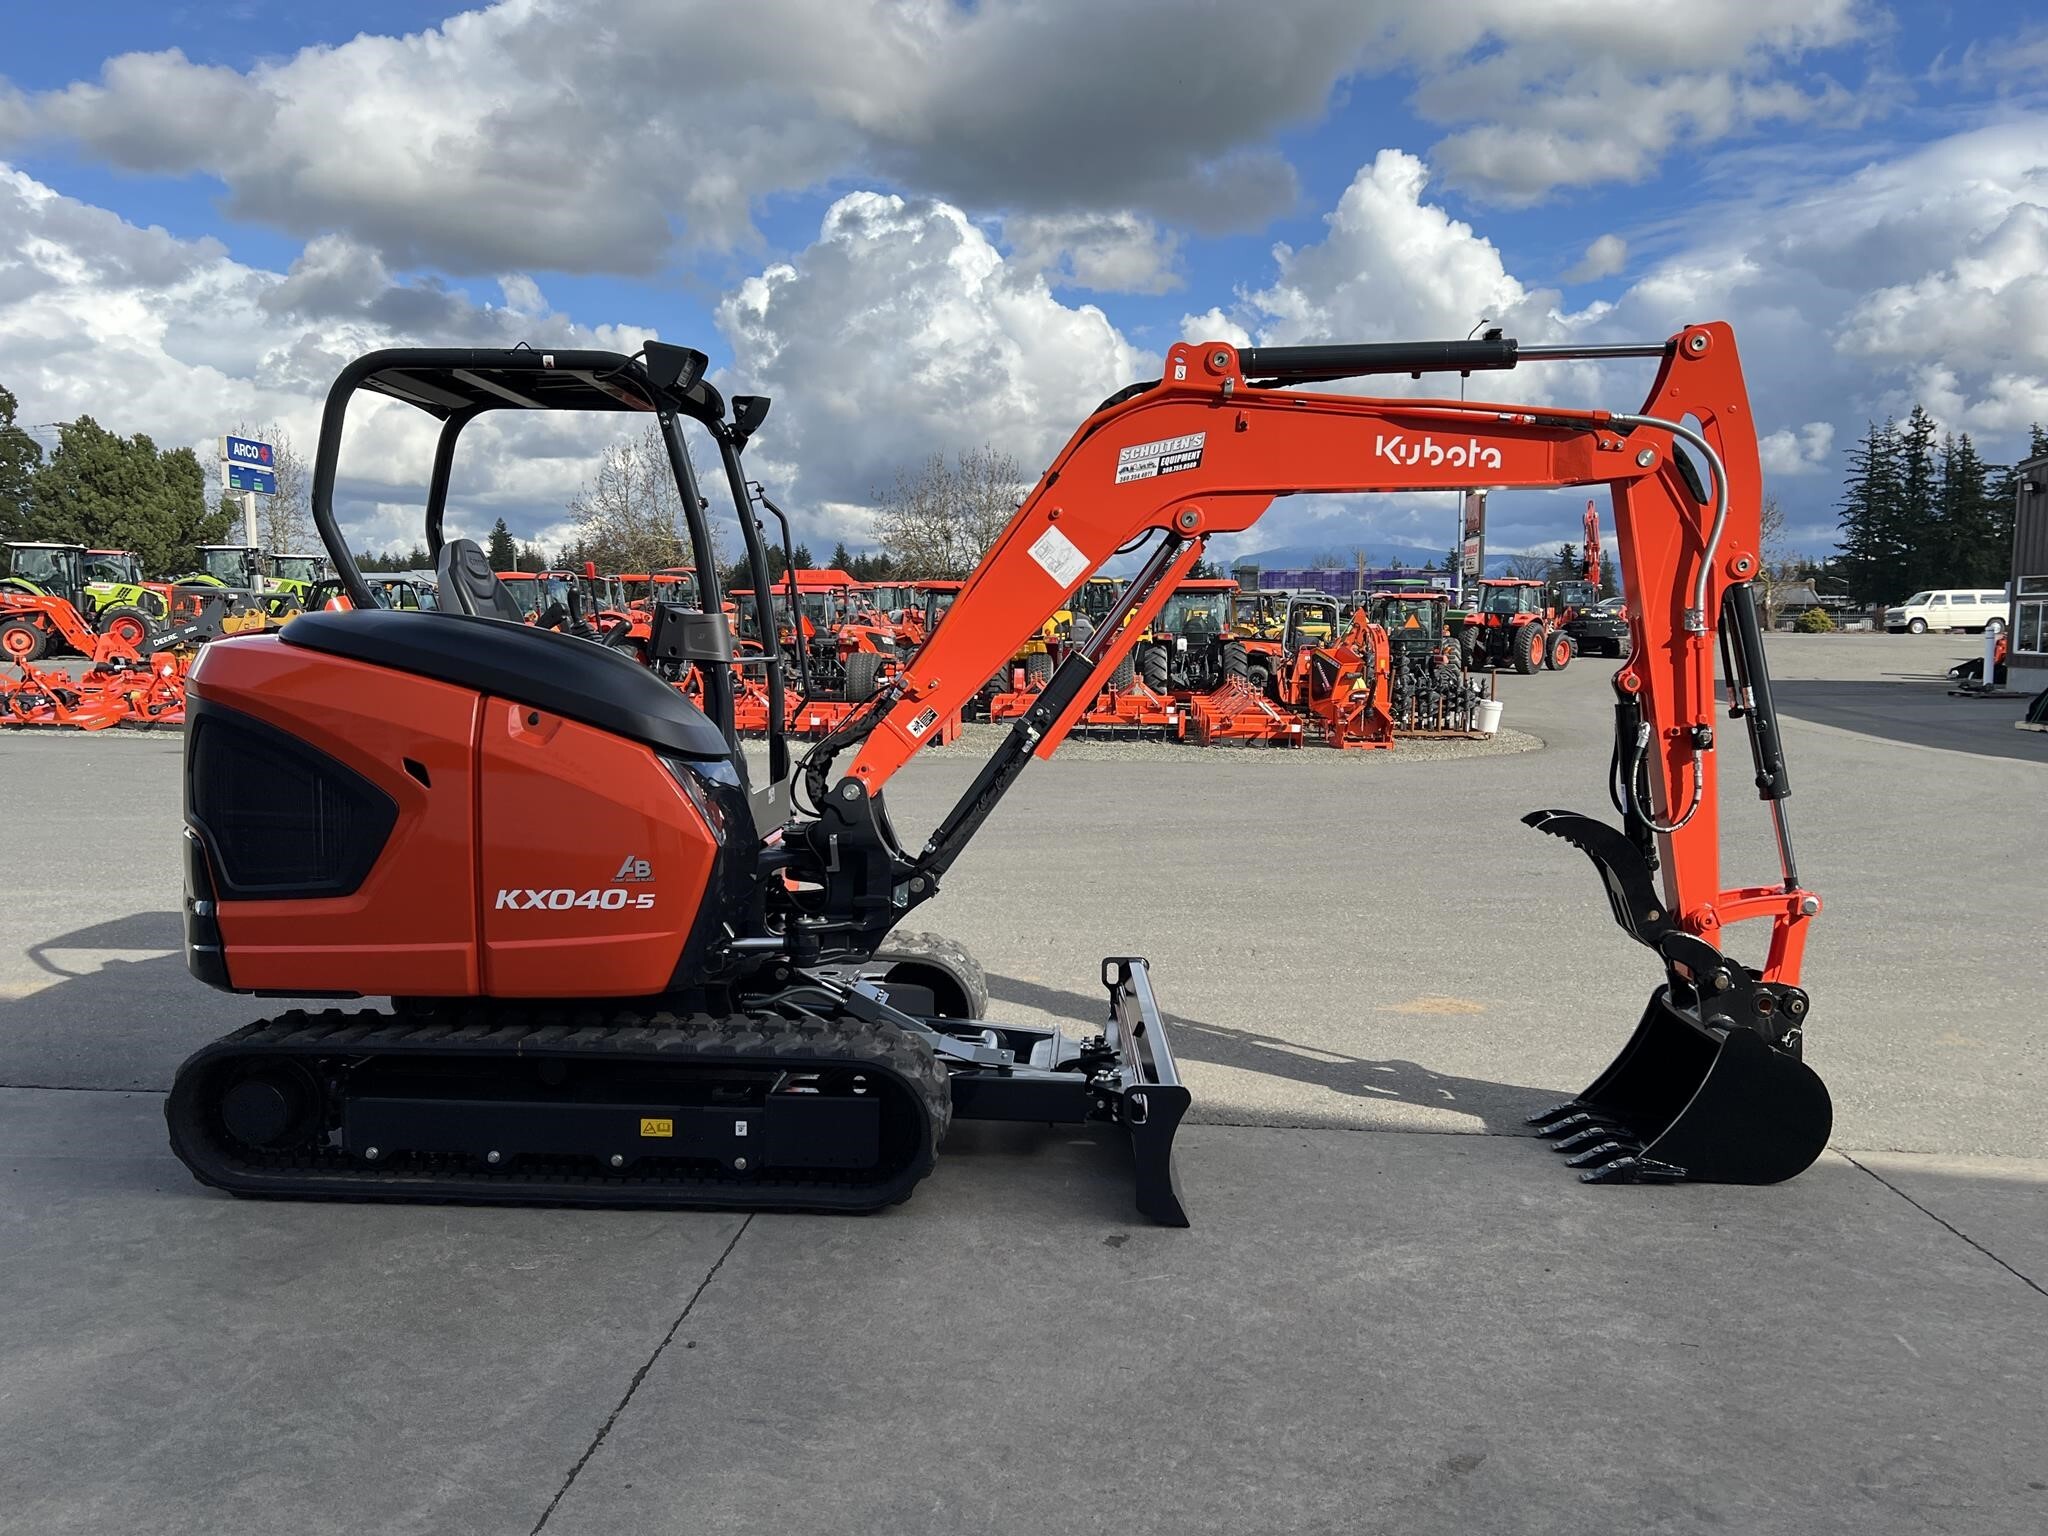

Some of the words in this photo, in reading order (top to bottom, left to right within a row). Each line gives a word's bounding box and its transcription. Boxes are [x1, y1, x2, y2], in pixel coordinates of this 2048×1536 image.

[233, 442, 259, 460] ARCO
[1120, 435, 1204, 461] SCHOLTEN'S
[1375, 435, 1502, 469] Kubota
[1160, 450, 1202, 467] EQUIPMENT
[152, 632, 179, 647] DEERE
[495, 888, 656, 910] KX040-5
